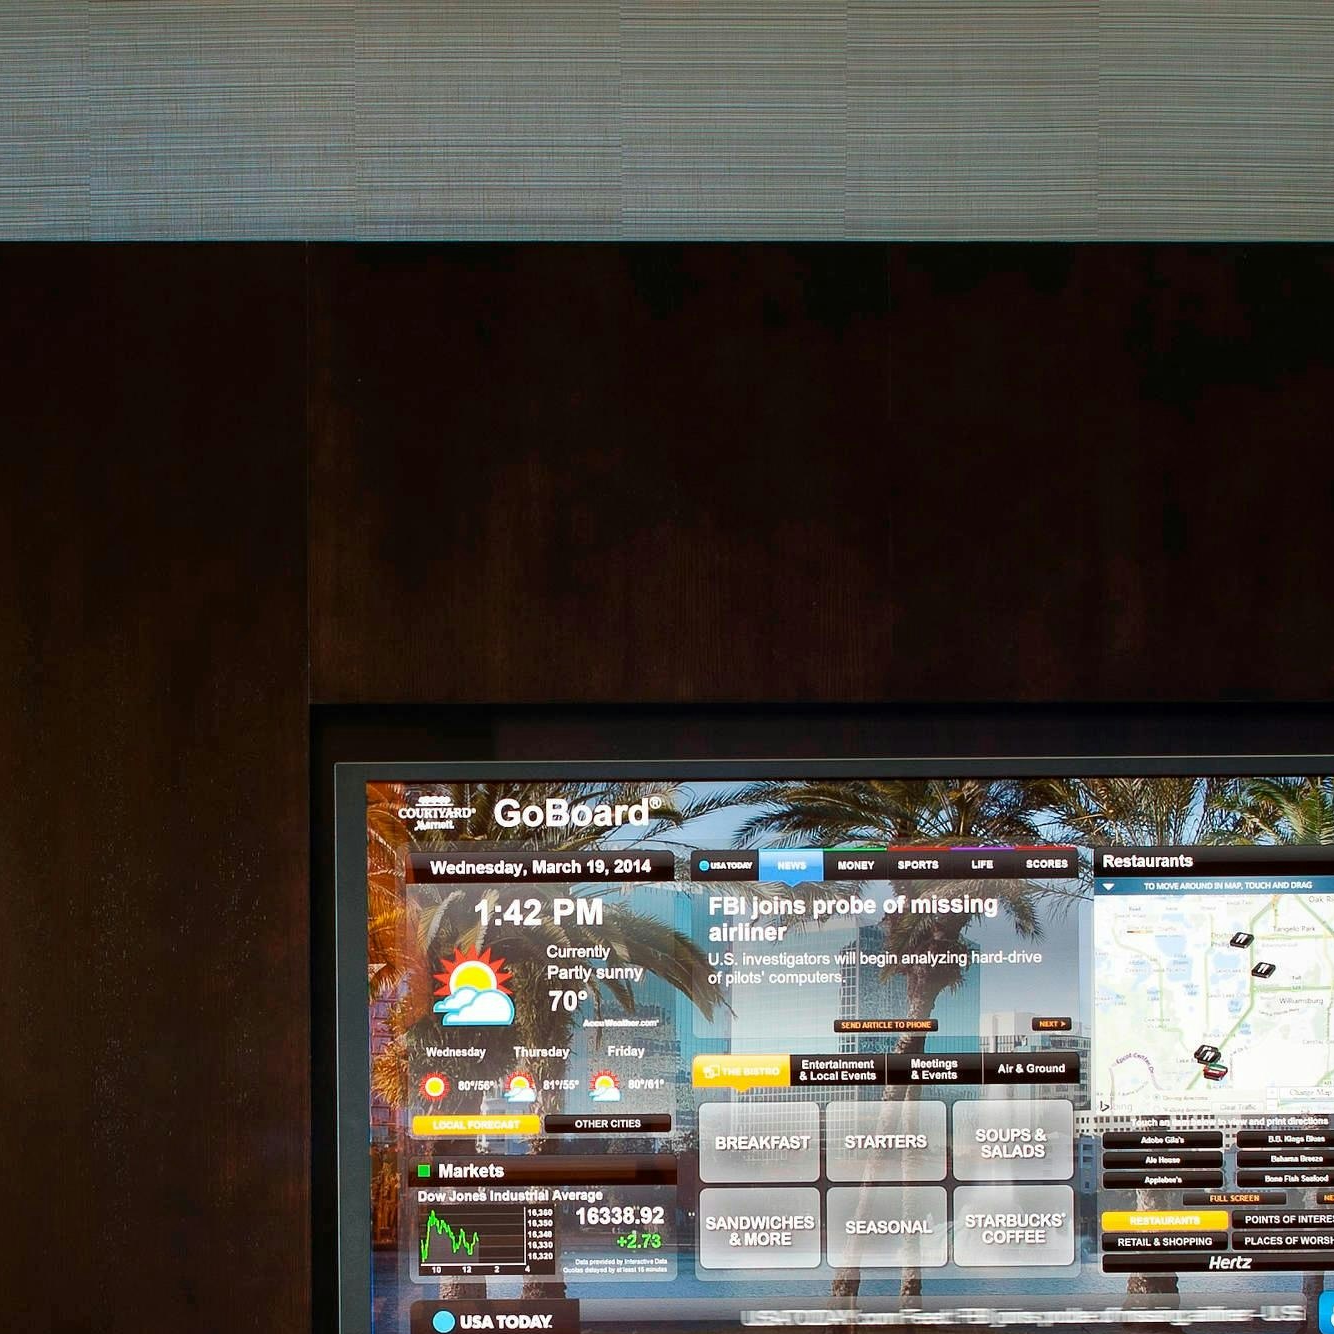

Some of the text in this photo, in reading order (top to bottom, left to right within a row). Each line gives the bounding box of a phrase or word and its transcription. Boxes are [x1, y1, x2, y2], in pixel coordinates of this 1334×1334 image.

[710, 861, 753, 870] USA TODAY
[777, 861, 807, 870] NEWS
[837, 860, 875, 871] MONEY
[898, 860, 939, 870] SPORTS
[971, 860, 993, 869] LIFE
[1025, 859, 1068, 869] SCORES
[1103, 853, 1193, 868] Restaurants
[430, 859, 652, 877] Wednesday, March 19, 2014
[1144, 882, 1155, 890] TO
[1156, 882, 1180, 890] MOVE
[1180, 882, 1213, 890] AROUND
[1214, 882, 1223, 890] IN
[1245, 881, 1271, 890] TOUCH
[1272, 881, 1290, 890] AND
[1290, 881, 1312, 890] DRAG
[1308, 896, 1325, 904] Oak
[473, 899, 603, 926] 1:42 PM
[709, 895, 998, 919] FBI joins probe of missing
[708, 924, 787, 942] airliner
[546, 944, 610, 961] Currently
[708, 950, 1042, 970] U.S. investigators will begin analyzing hard-drive
[547, 965, 643, 982] Partly sunny
[708, 971, 846, 988] of pilots' computers.
[549, 990, 588, 1012] 70°
[841, 1021, 931, 1030] SEND ARTICLE TO PHONE
[1039, 1020, 1058, 1028] NEXT
[425, 1046, 486, 1059] Wednesday
[513, 1046, 570, 1060] Thursday
[607, 1045, 645, 1059] Friday
[801, 1059, 875, 1071] Entertainment
[911, 1058, 958, 1072] Meetings
[997, 1062, 1066, 1074] Air & Ground
[722, 1067, 780, 1076] THE BISTRO
[799, 1070, 877, 1081] & Local Events
[911, 1069, 958, 1080] & Events
[433, 1119, 520, 1130] LOCAL FORECAST
[575, 1119, 642, 1129] OTHER CITIES
[1131, 1118, 1158, 1127] Touch
[1159, 1119, 1170, 1127] an
[1218, 1118, 1226, 1126] to
[1227, 1118, 1247, 1126] view
[1248, 1117, 1265, 1126] and
[1266, 1117, 1286, 1128] print
[1287, 1117, 1328, 1126] directions
[845, 1134, 928, 1149] STARTERS
[975, 1128, 1048, 1143] SOUPS &
[1141, 1136, 1164, 1144] Adobe
[715, 1135, 811, 1151] BREAKFAST
[981, 1144, 1046, 1158] SALADS
[1145, 1156, 1180, 1164] Ale House
[1271, 1155, 1324, 1163] Bahama Breeze
[438, 1163, 505, 1179] Markets
[1144, 1175, 1182, 1185] Applebee's
[1265, 1174, 1329, 1183] Bone Fish Seafood
[418, 1190, 604, 1204] Dow Jones Industrial Average
[1210, 1194, 1260, 1202] FULL SCREEN
[575, 1206, 665, 1225] 16338.92
[1130, 1216, 1200, 1225] RESTAURANTS
[1245, 1215, 1280, 1224] POINTS
[1282, 1215, 1297, 1223] OF
[706, 1215, 815, 1230] SANDWICHES
[845, 1220, 933, 1235] SEASONAL
[617, 1233, 662, 1249] +2.73
[729, 1232, 792, 1246] & MORE
[982, 1230, 1046, 1244] COFFEE
[1118, 1237, 1213, 1247] RETAIL & SHOPPING
[1244, 1236, 1283, 1245] PLACES
[1285, 1236, 1299, 1245] OF
[616, 1259, 624, 1267] by
[1209, 1255, 1252, 1269] Hertz
[431, 1265, 531, 1274] 10 12 2 4
[608, 1267, 616, 1275] by
[460, 1314, 494, 1329] USA
